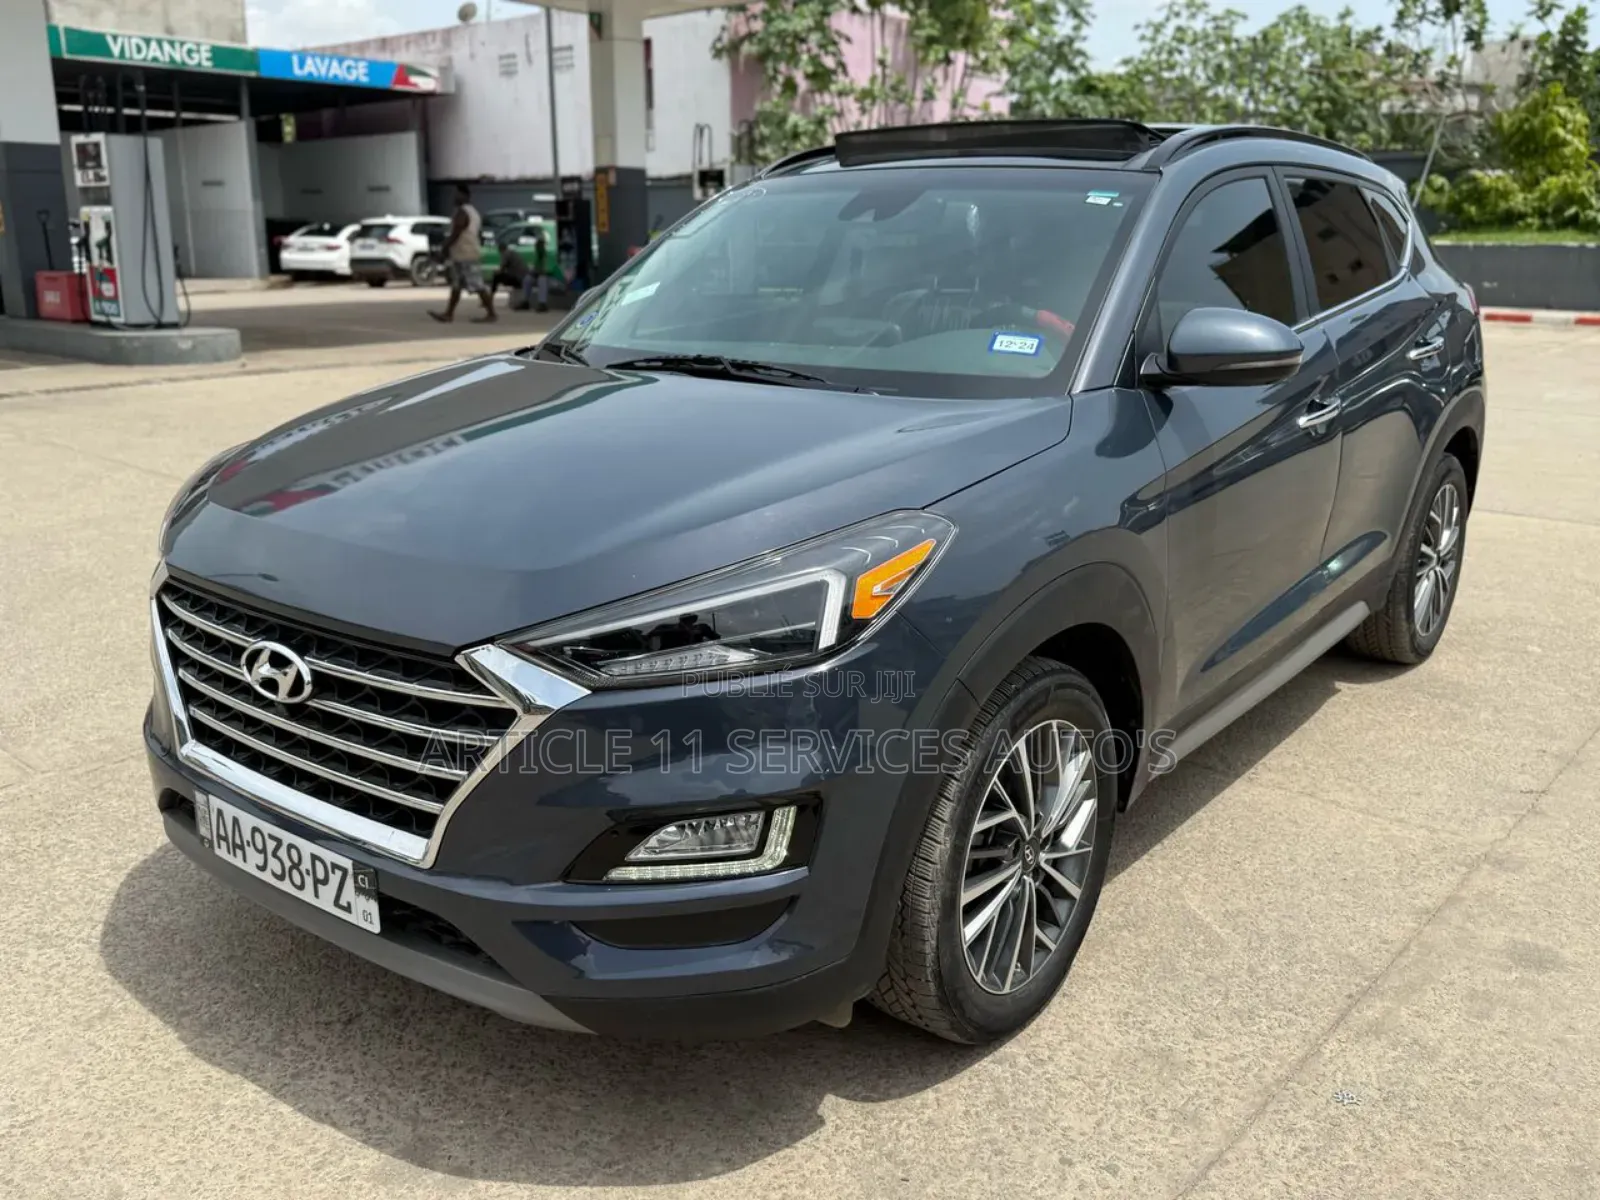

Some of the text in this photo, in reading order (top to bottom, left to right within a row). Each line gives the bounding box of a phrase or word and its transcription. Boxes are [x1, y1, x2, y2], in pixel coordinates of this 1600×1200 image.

[105, 34, 214, 67] VIDANGE
[291, 53, 370, 82] LAVAGE
[358, 874, 369, 890] CI
[362, 909, 375, 925] 01
